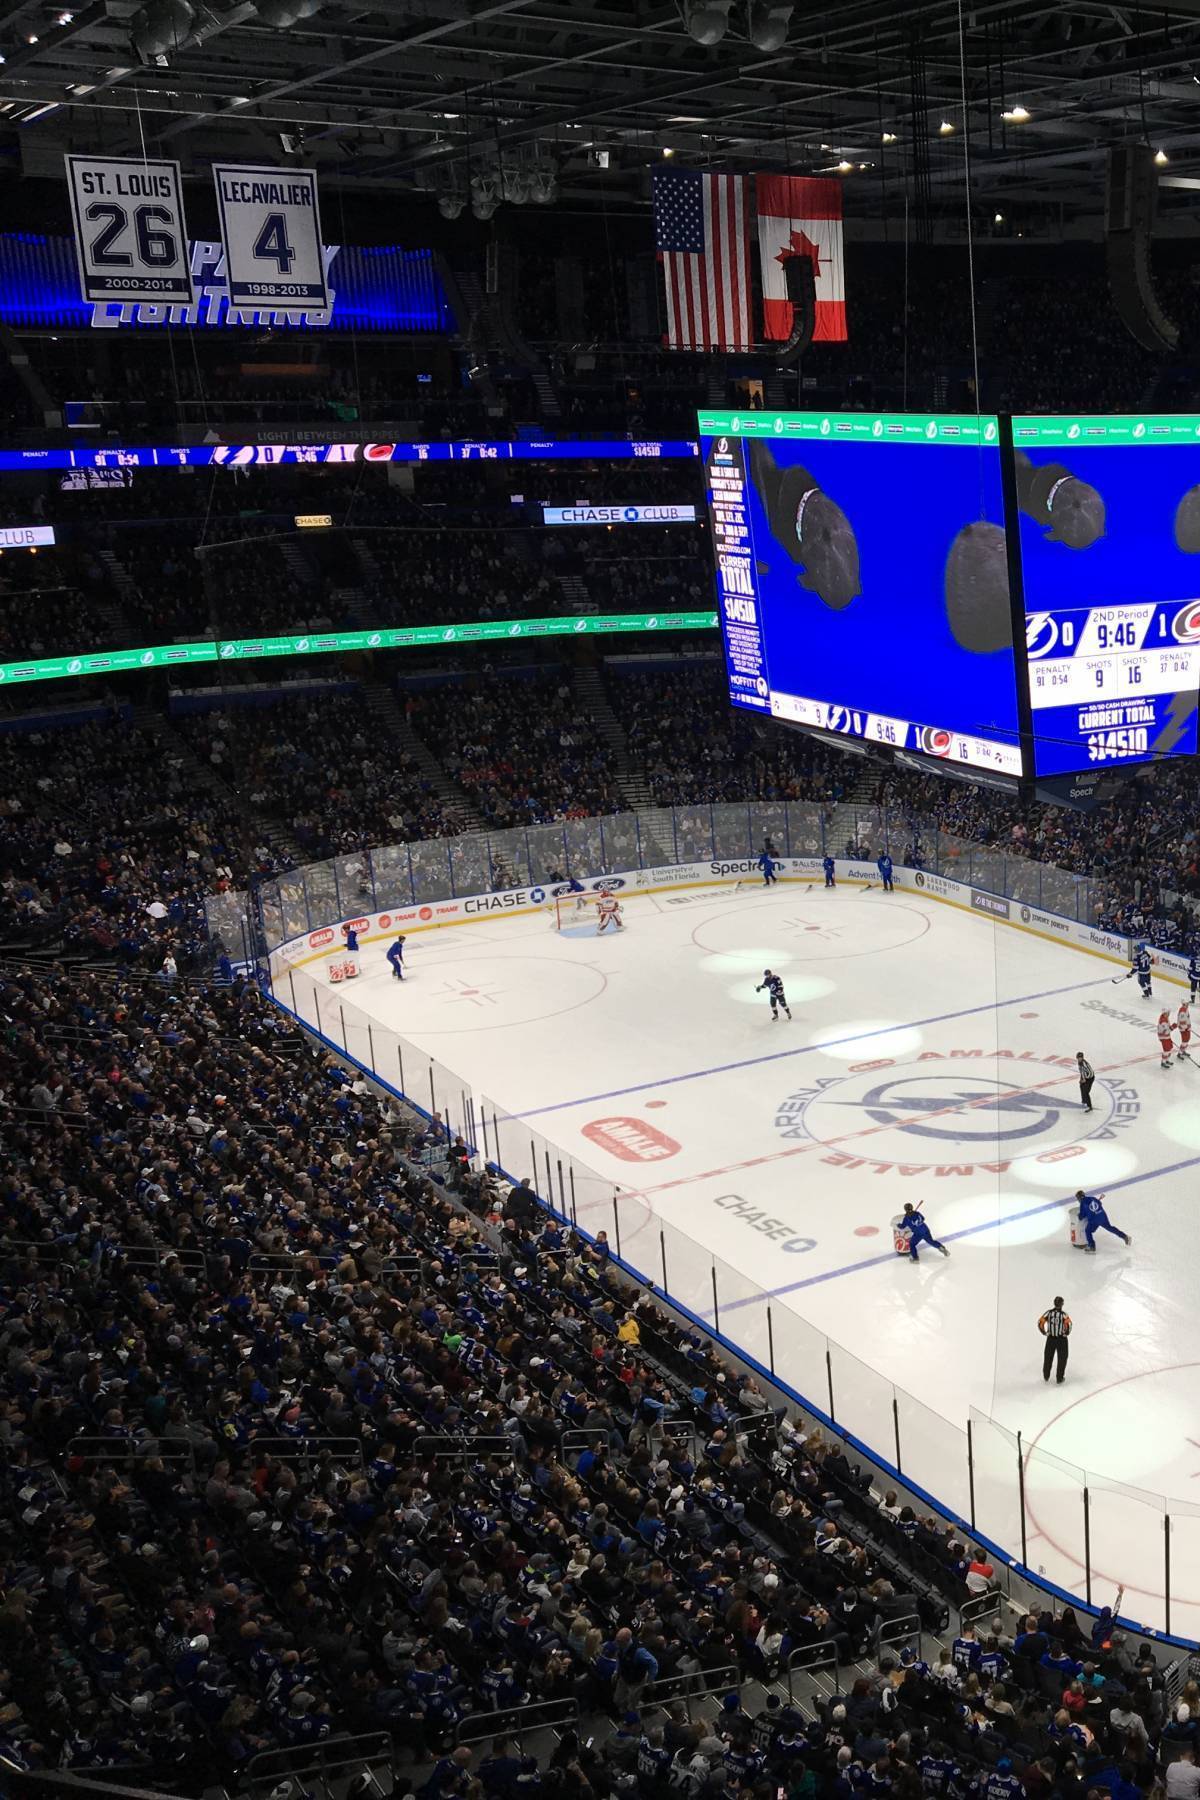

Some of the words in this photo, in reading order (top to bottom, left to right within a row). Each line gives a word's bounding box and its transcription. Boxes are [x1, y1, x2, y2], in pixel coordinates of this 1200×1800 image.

[82, 171, 111, 195] ST.
[117, 174, 171, 198] LOUIS
[223, 181, 312, 206] LECAVALIER
[85, 202, 178, 268] 26
[253, 212, 295, 274] 4
[104, 278, 173, 290] 2000-2014
[247, 284, 309, 296] 1998-2013
[257, 431, 289, 441] LIGHT
[296, 431, 348, 441] BETWEEN
[179, 454, 186, 464] 9
[264, 447, 273, 462] 0
[561, 508, 621, 521] CHASE
[643, 508, 679, 520] CLUB
[718, 554, 751, 569] CURRENT
[720, 565, 754, 595] TOTAL
[1092, 612, 1115, 623] 2ND
[1117, 610, 1149, 620] Period
[1158, 613, 1167, 637] 1
[1062, 621, 1074, 646] 0
[1098, 622, 1136, 648] 9:46
[1086, 659, 1112, 670] SHOTS
[1122, 656, 1148, 666] SHOTS
[1160, 652, 1192, 662] PENALTY
[1035, 664, 1071, 675] PENALTY
[1128, 665, 1142, 685] 16
[1160, 662, 1168, 673] 37
[1095, 669, 1104, 688] 9
[853, 712, 862, 734] 0
[1078, 707, 1124, 730] CURRENT
[1125, 705, 1155, 723] TOTAL
[876, 722, 896, 742] 9:46
[915, 726, 922, 748] 1
[958, 742, 969, 760] 16
[1087, 727, 1148, 761] $14510
[652, 867, 688, 876] University
[652, 874, 672, 883] South
[674, 872, 700, 881] Florida
[598, 880, 620, 890] Ford
[926, 875, 960, 892] LAKEWOOD
[436, 905, 459, 914] TRANE
[464, 892, 526, 913] CHASE
[395, 912, 416, 922] TRANE
[1089, 932, 1106, 946] Hard
[1106, 937, 1121, 952] Rock
[775, 1077, 848, 1139] ARENA
[1086, 1078, 1140, 1140] ARENA
[593, 1121, 671, 1159] AMALIE
[713, 1194, 797, 1241] CHASE
